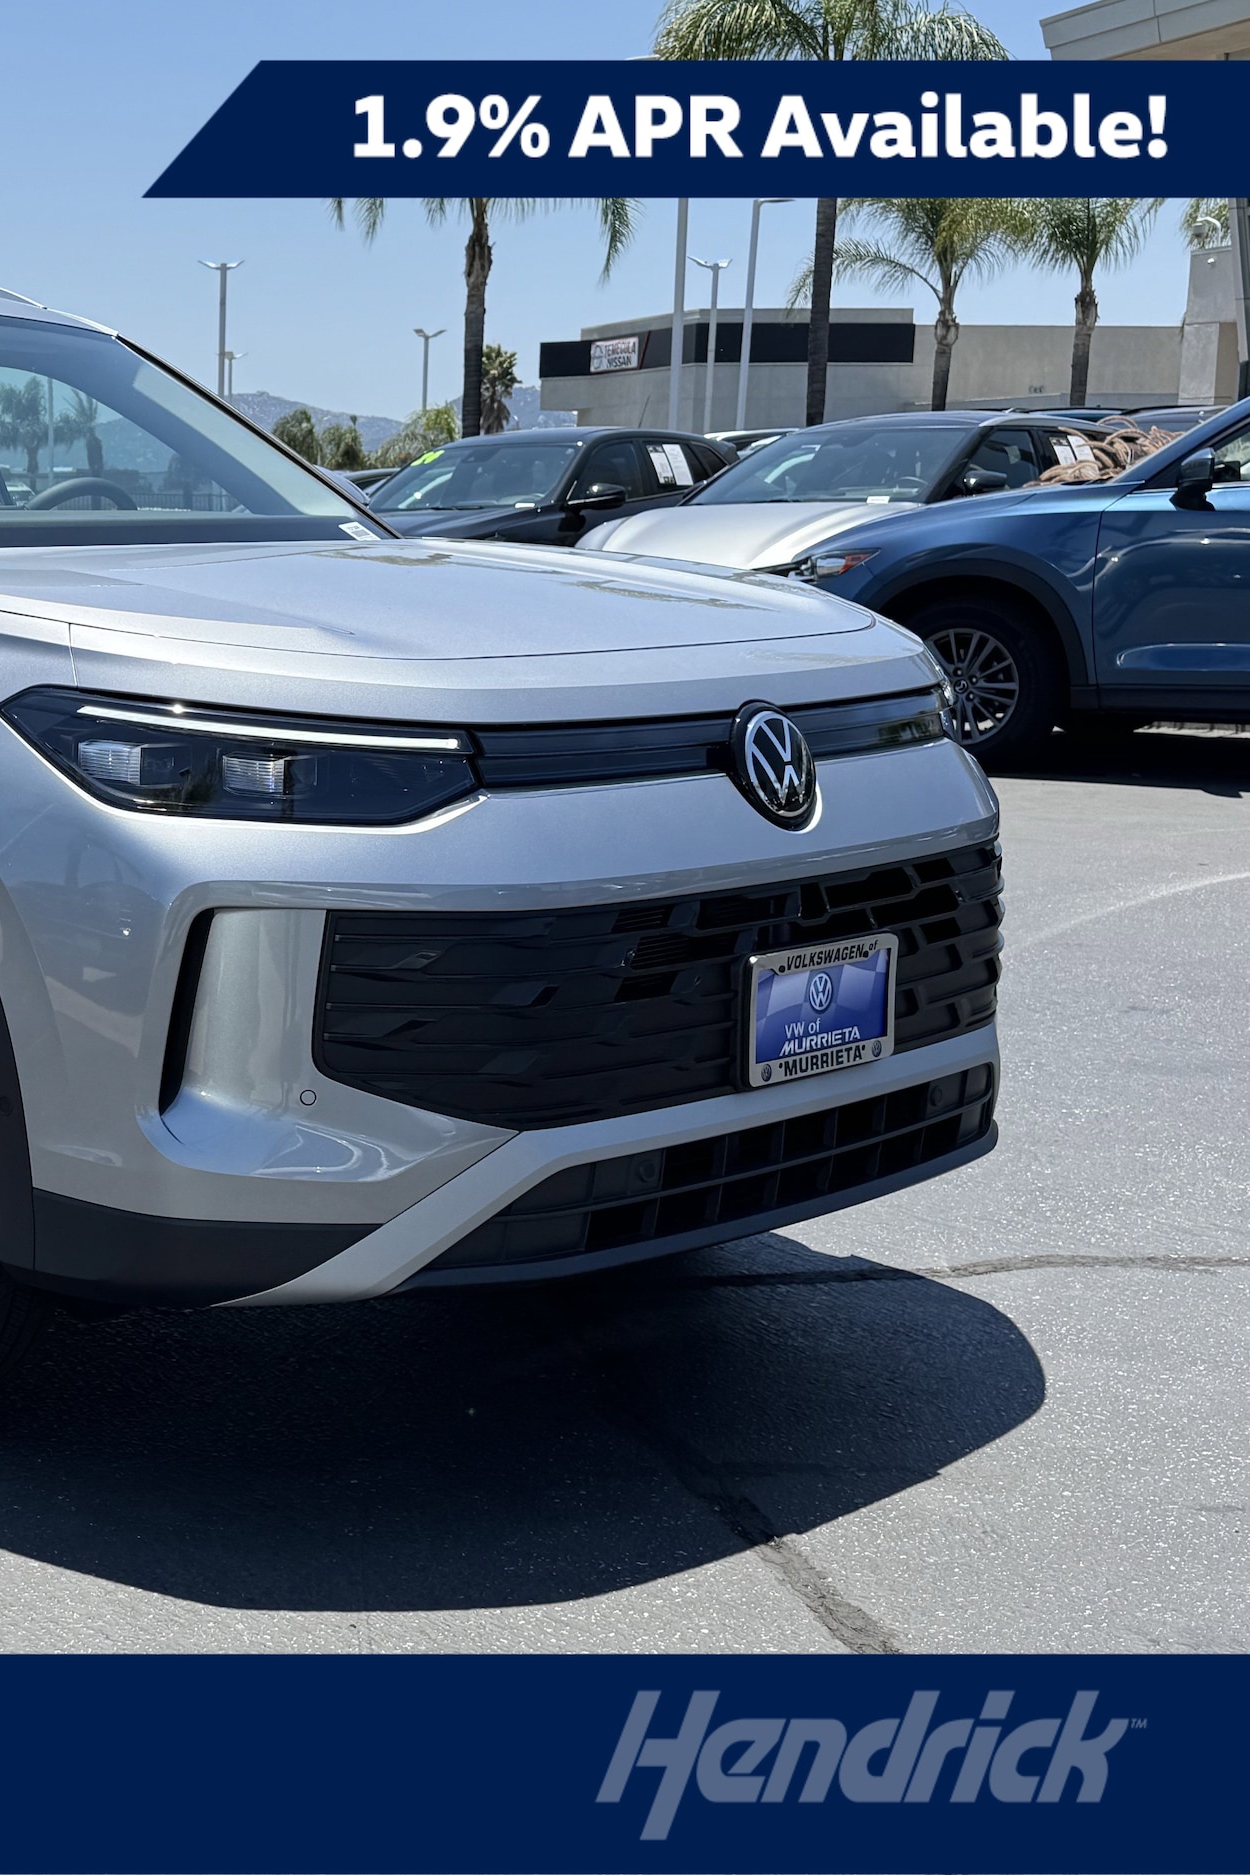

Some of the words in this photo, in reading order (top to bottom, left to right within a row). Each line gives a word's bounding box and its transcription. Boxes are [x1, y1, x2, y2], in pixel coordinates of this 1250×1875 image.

[605, 341, 636, 357] TEMECULA
[607, 355, 632, 368] NISSAN
[787, 943, 864, 970] VOLKSWAGEN
[869, 940, 878, 951] of
[785, 1021, 804, 1038] VW
[808, 1018, 820, 1034] of
[779, 1026, 861, 1056] MURRIETA
[784, 1045, 863, 1077] MURRIETA
